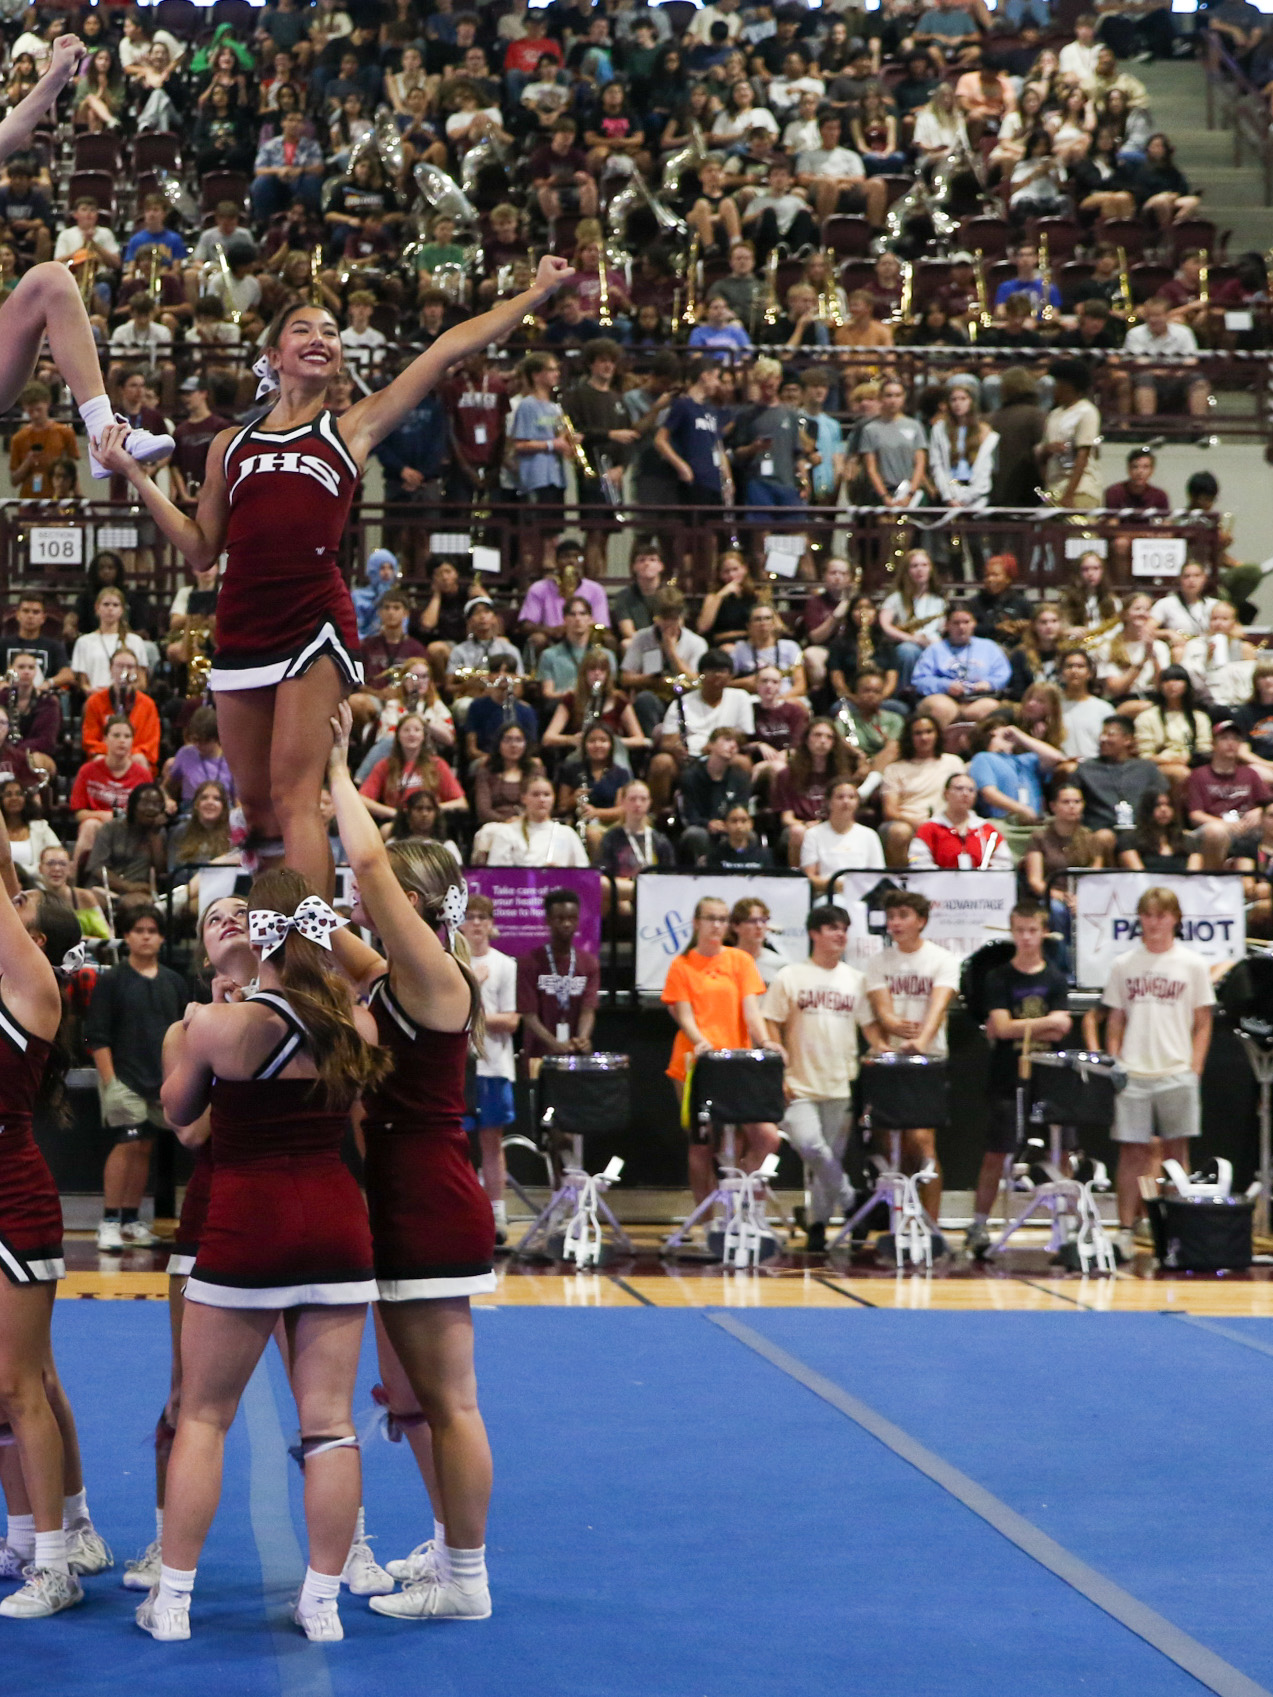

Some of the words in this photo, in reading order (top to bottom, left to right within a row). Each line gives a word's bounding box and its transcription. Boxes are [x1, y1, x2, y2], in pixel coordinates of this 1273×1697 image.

[229, 452, 341, 506] JHS
[38, 540, 75, 558] 108
[1112, 919, 1235, 942] PAIOT
